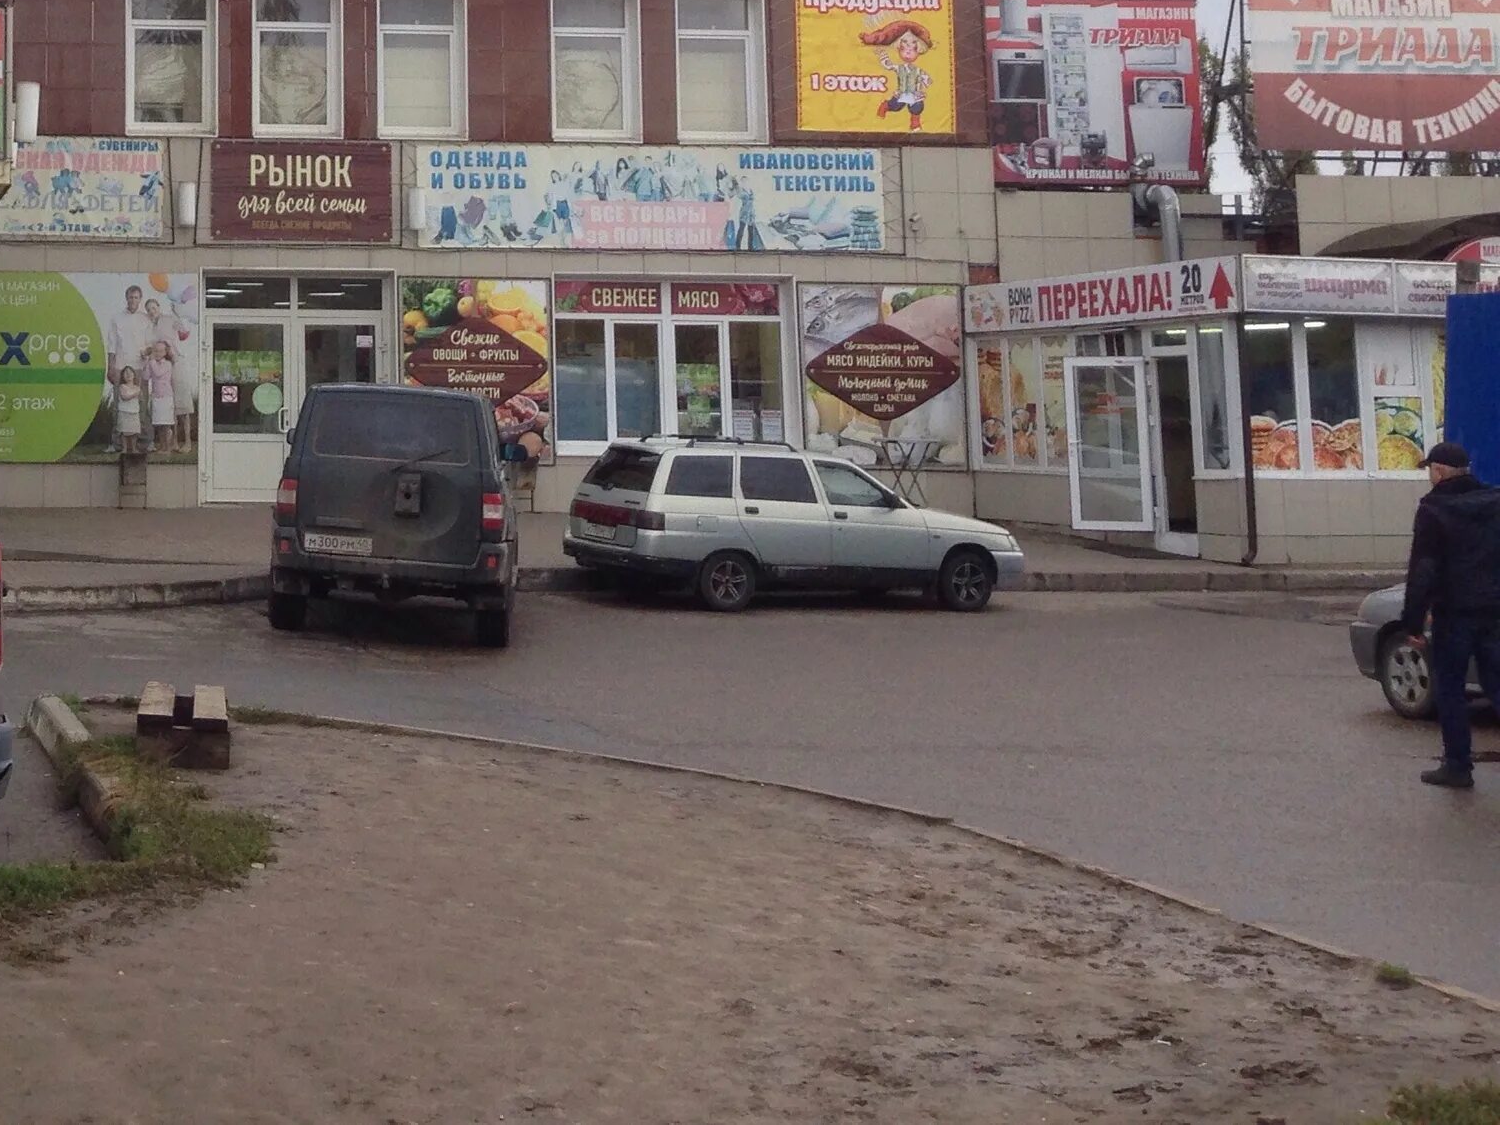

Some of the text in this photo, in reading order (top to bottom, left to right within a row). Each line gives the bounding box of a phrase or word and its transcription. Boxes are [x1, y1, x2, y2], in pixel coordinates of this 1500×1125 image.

[1135, 7, 1189, 20] МАГАЗИН
[1089, 27, 1184, 48] ТРИАДА
[1292, 26, 1495, 67] ТРИАДА
[824, 75, 887, 92] этаж
[1283, 78, 1403, 145] БЫТОВАЯ
[98, 140, 159, 152] СУВЕНИРЫ
[430, 150, 528, 169] ОДЕЖДА
[738, 148, 876, 171] ИВАНОВСКИЙ
[250, 154, 352, 187] РЫНОК
[1076, 170, 1113, 180] МЕЛКАЯ
[1160, 170, 1200, 181] ТЕХНИКА
[431, 172, 528, 190] И ОБУВЬ
[772, 174, 876, 193] ТЕКСТИЛЬ
[84, 194, 160, 213] ДЕТЕЙ
[238, 190, 367, 219] для всей семьи
[589, 205, 707, 224] ВСЕ ТОВАРЫ
[7, 281, 60, 292] МАГАЗИН
[1180, 264, 1202, 293] 20
[592, 286, 719, 308] СВЕЖЕЕ МЯСО
[1037, 271, 1173, 321] ПЕРЕЕХАЛА!
[450, 328, 500, 346] Свежие
[432, 348, 519, 361] ОВОЩИ ФРУКТЫ
[827, 354, 854, 366] МЯСО
[907, 356, 934, 367] КУРЫ
[12, 397, 55, 410] этаж
[851, 393, 917, 402] МОЛОКО СМЕТАНА
[873, 403, 895, 412] СЫРЫ
